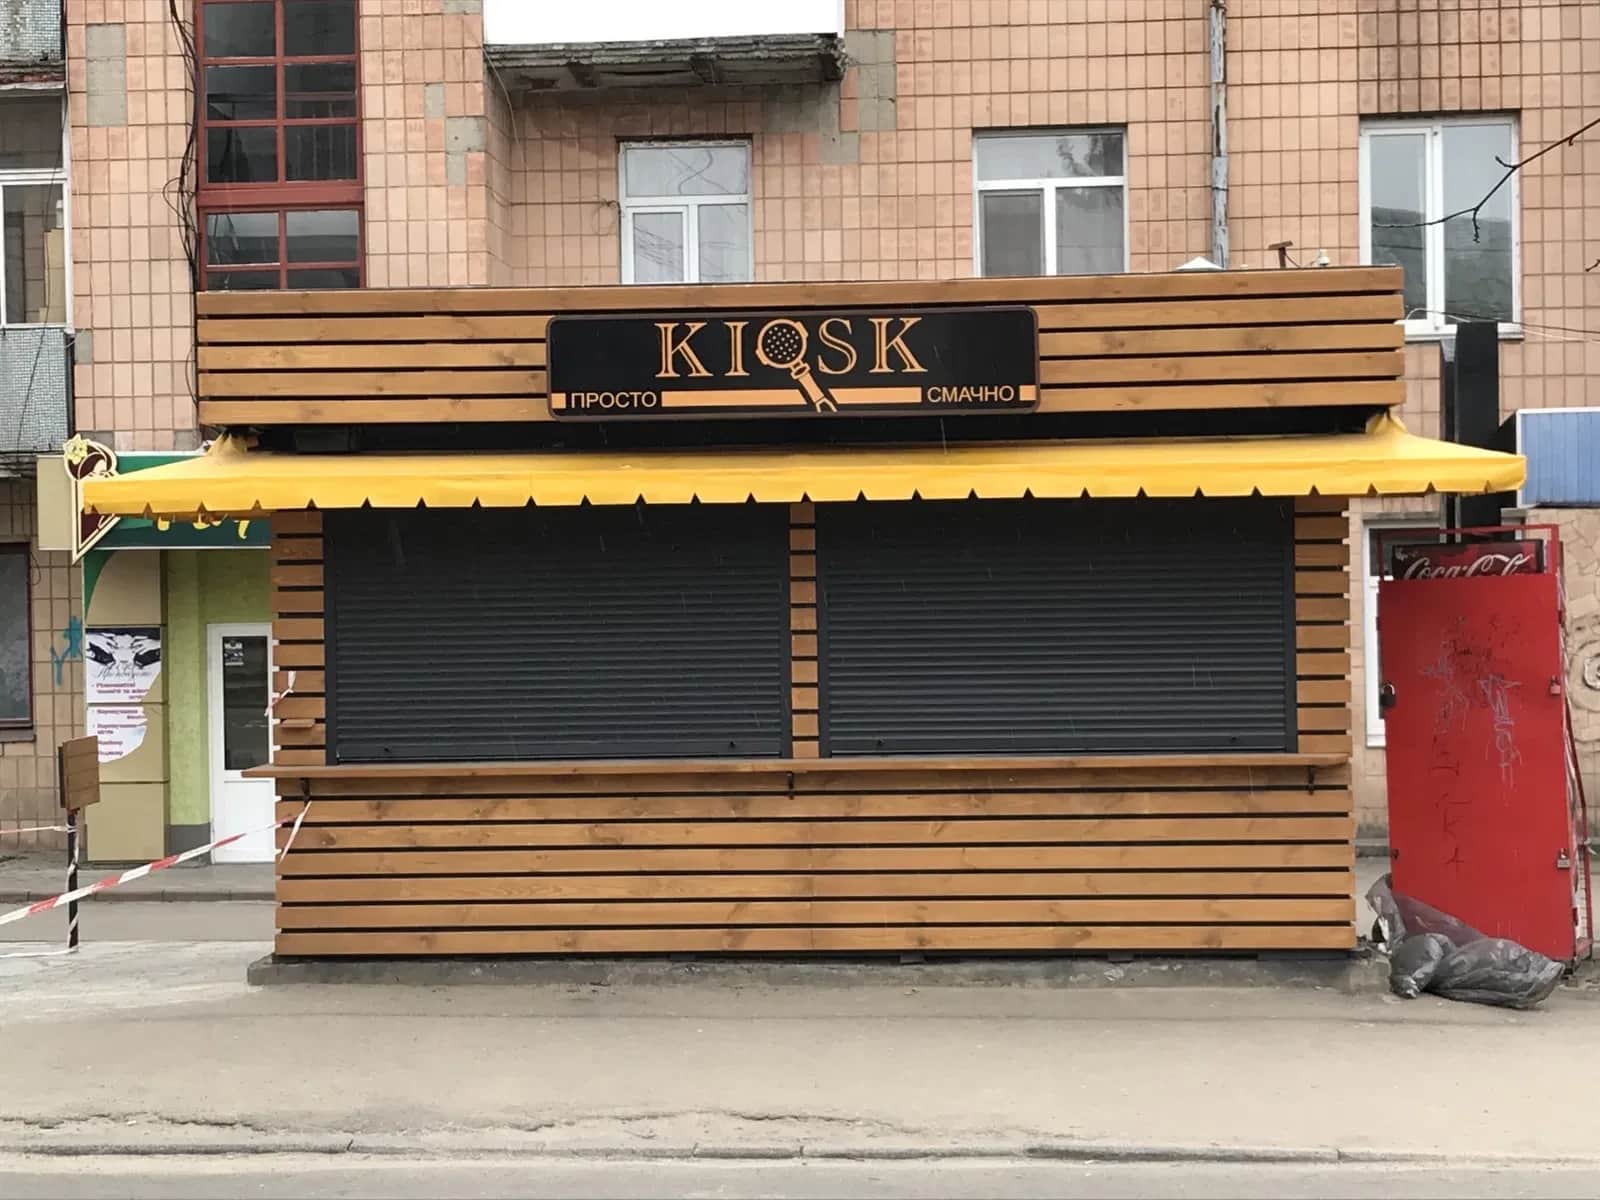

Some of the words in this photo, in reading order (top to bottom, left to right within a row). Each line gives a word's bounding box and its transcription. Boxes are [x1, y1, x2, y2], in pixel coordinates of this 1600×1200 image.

[654, 317, 929, 378] KIOSK
[570, 391, 658, 409] ПРОСТО
[927, 384, 1015, 404] СМАЧНО
[1404, 553, 1536, 580] Coca-Cl
